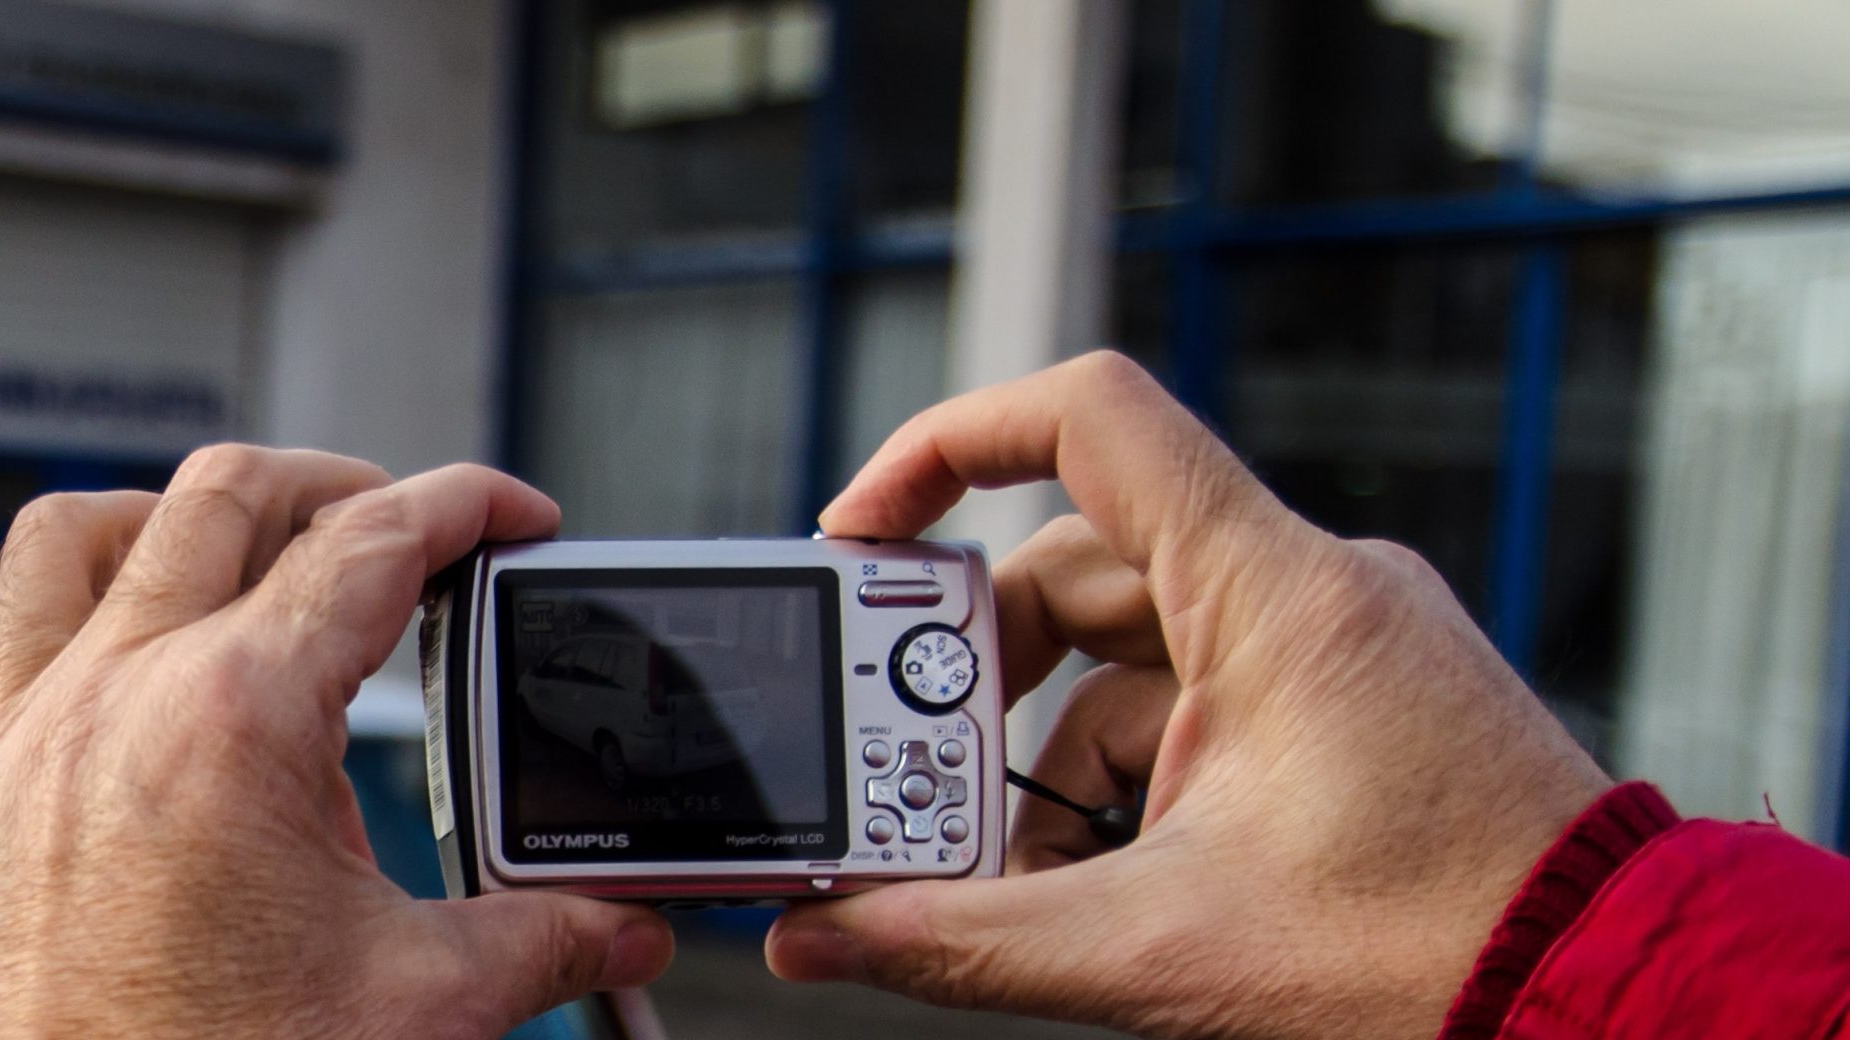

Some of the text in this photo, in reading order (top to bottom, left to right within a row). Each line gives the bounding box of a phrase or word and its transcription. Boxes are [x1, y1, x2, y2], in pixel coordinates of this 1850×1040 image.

[940, 649, 967, 669] GUIDE
[858, 726, 892, 736] MENU
[523, 833, 630, 849] OLYMPUS
[726, 833, 825, 847] HyperCrystal LCD
